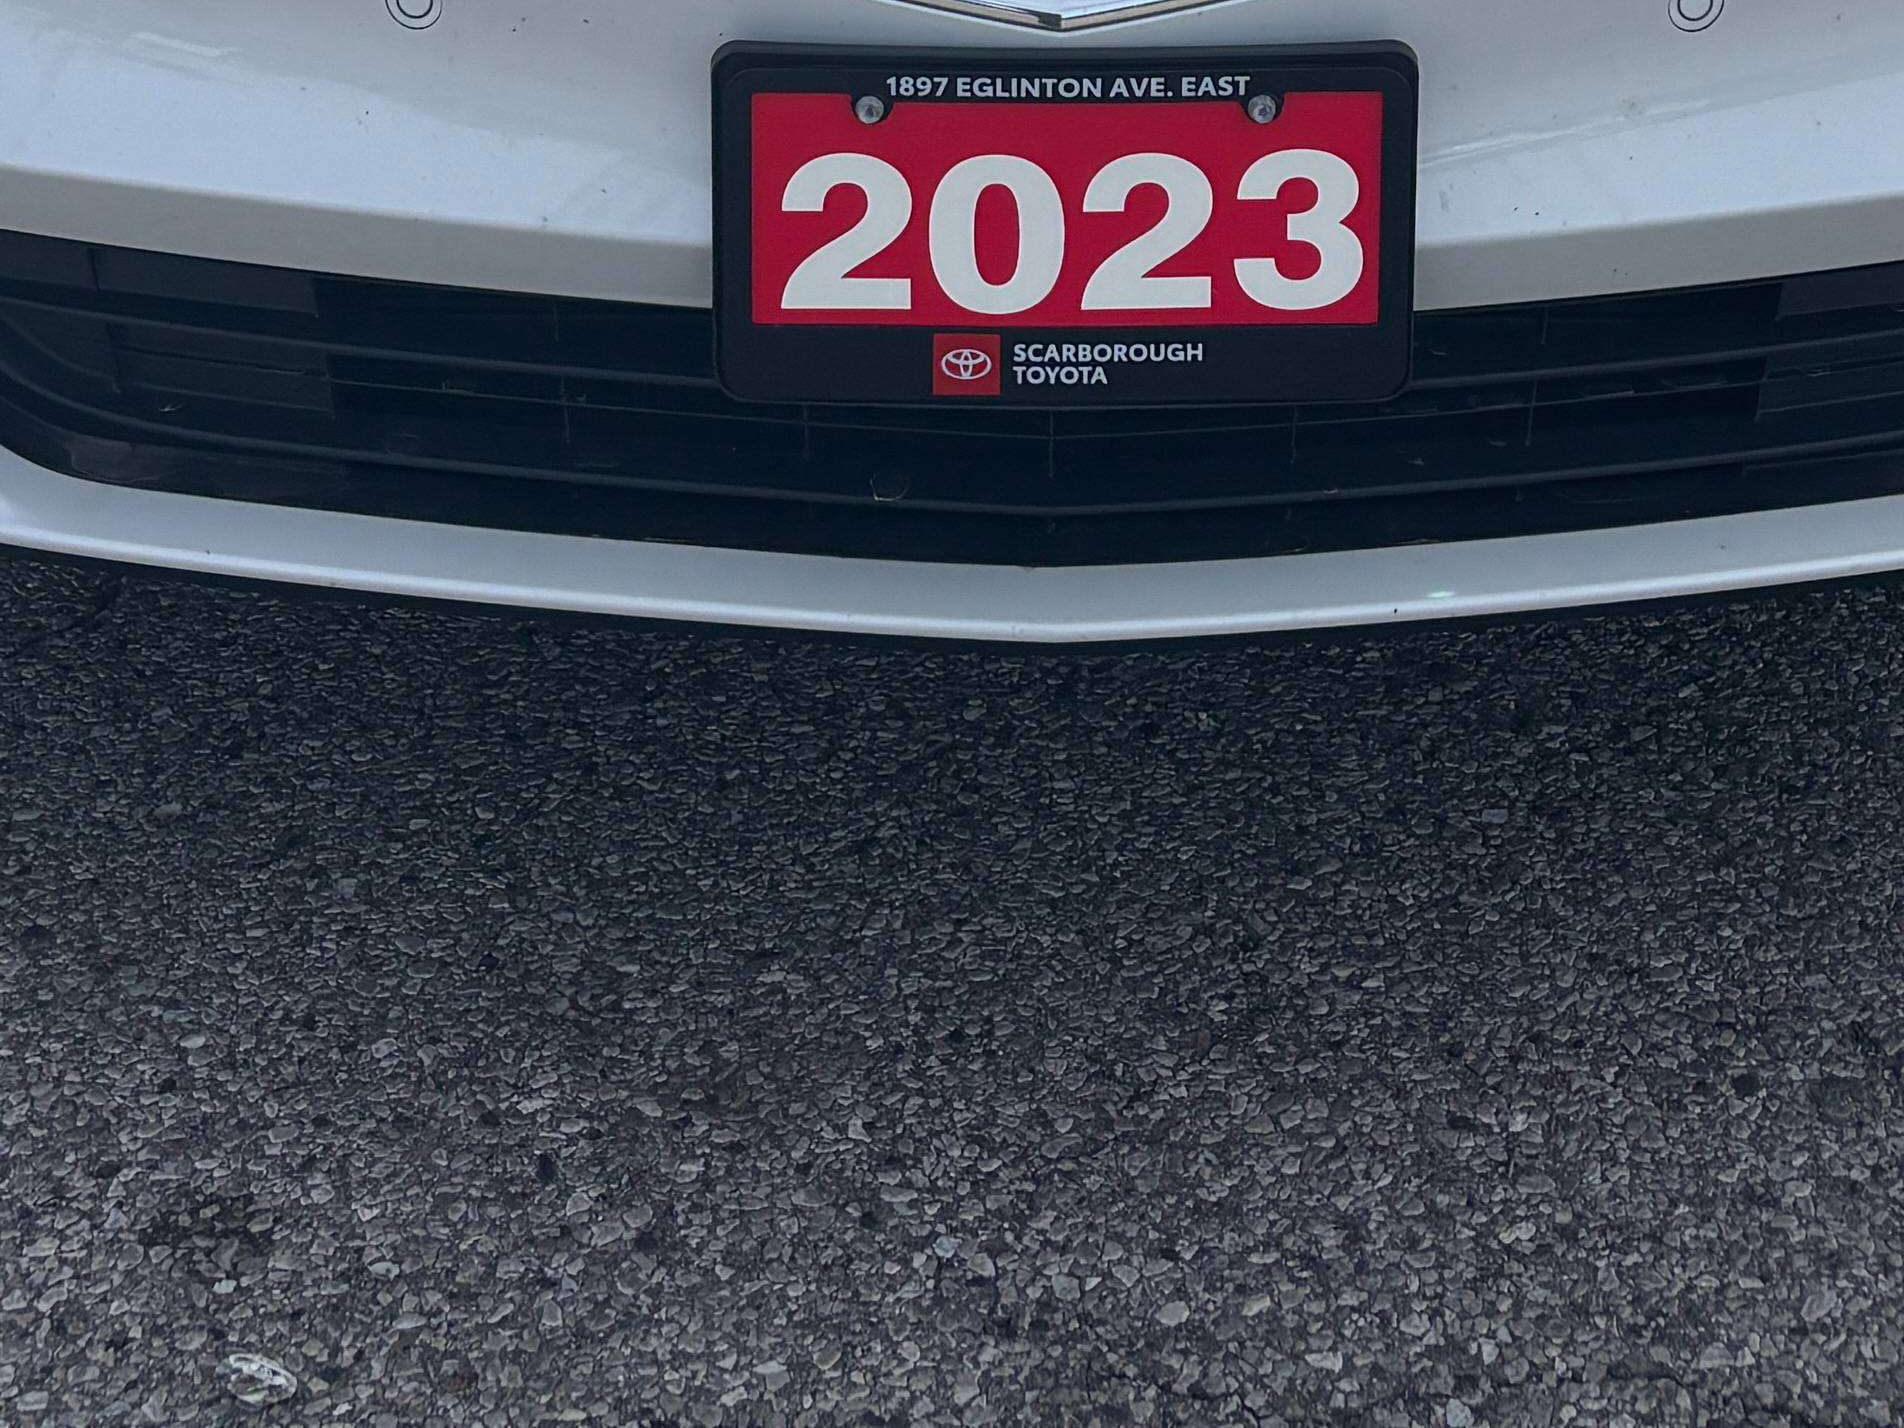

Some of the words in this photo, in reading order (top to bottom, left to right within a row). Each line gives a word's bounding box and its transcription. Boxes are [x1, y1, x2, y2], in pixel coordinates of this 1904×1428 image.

[885, 76, 948, 97] 1897
[956, 76, 1102, 100] EGLINTON
[1109, 76, 1174, 98] AVE.
[1180, 74, 1252, 97] EAST
[780, 148, 1365, 315] 2023
[1012, 342, 1204, 363] SCARBOROUGH
[1012, 365, 1109, 386] TOYOTA
